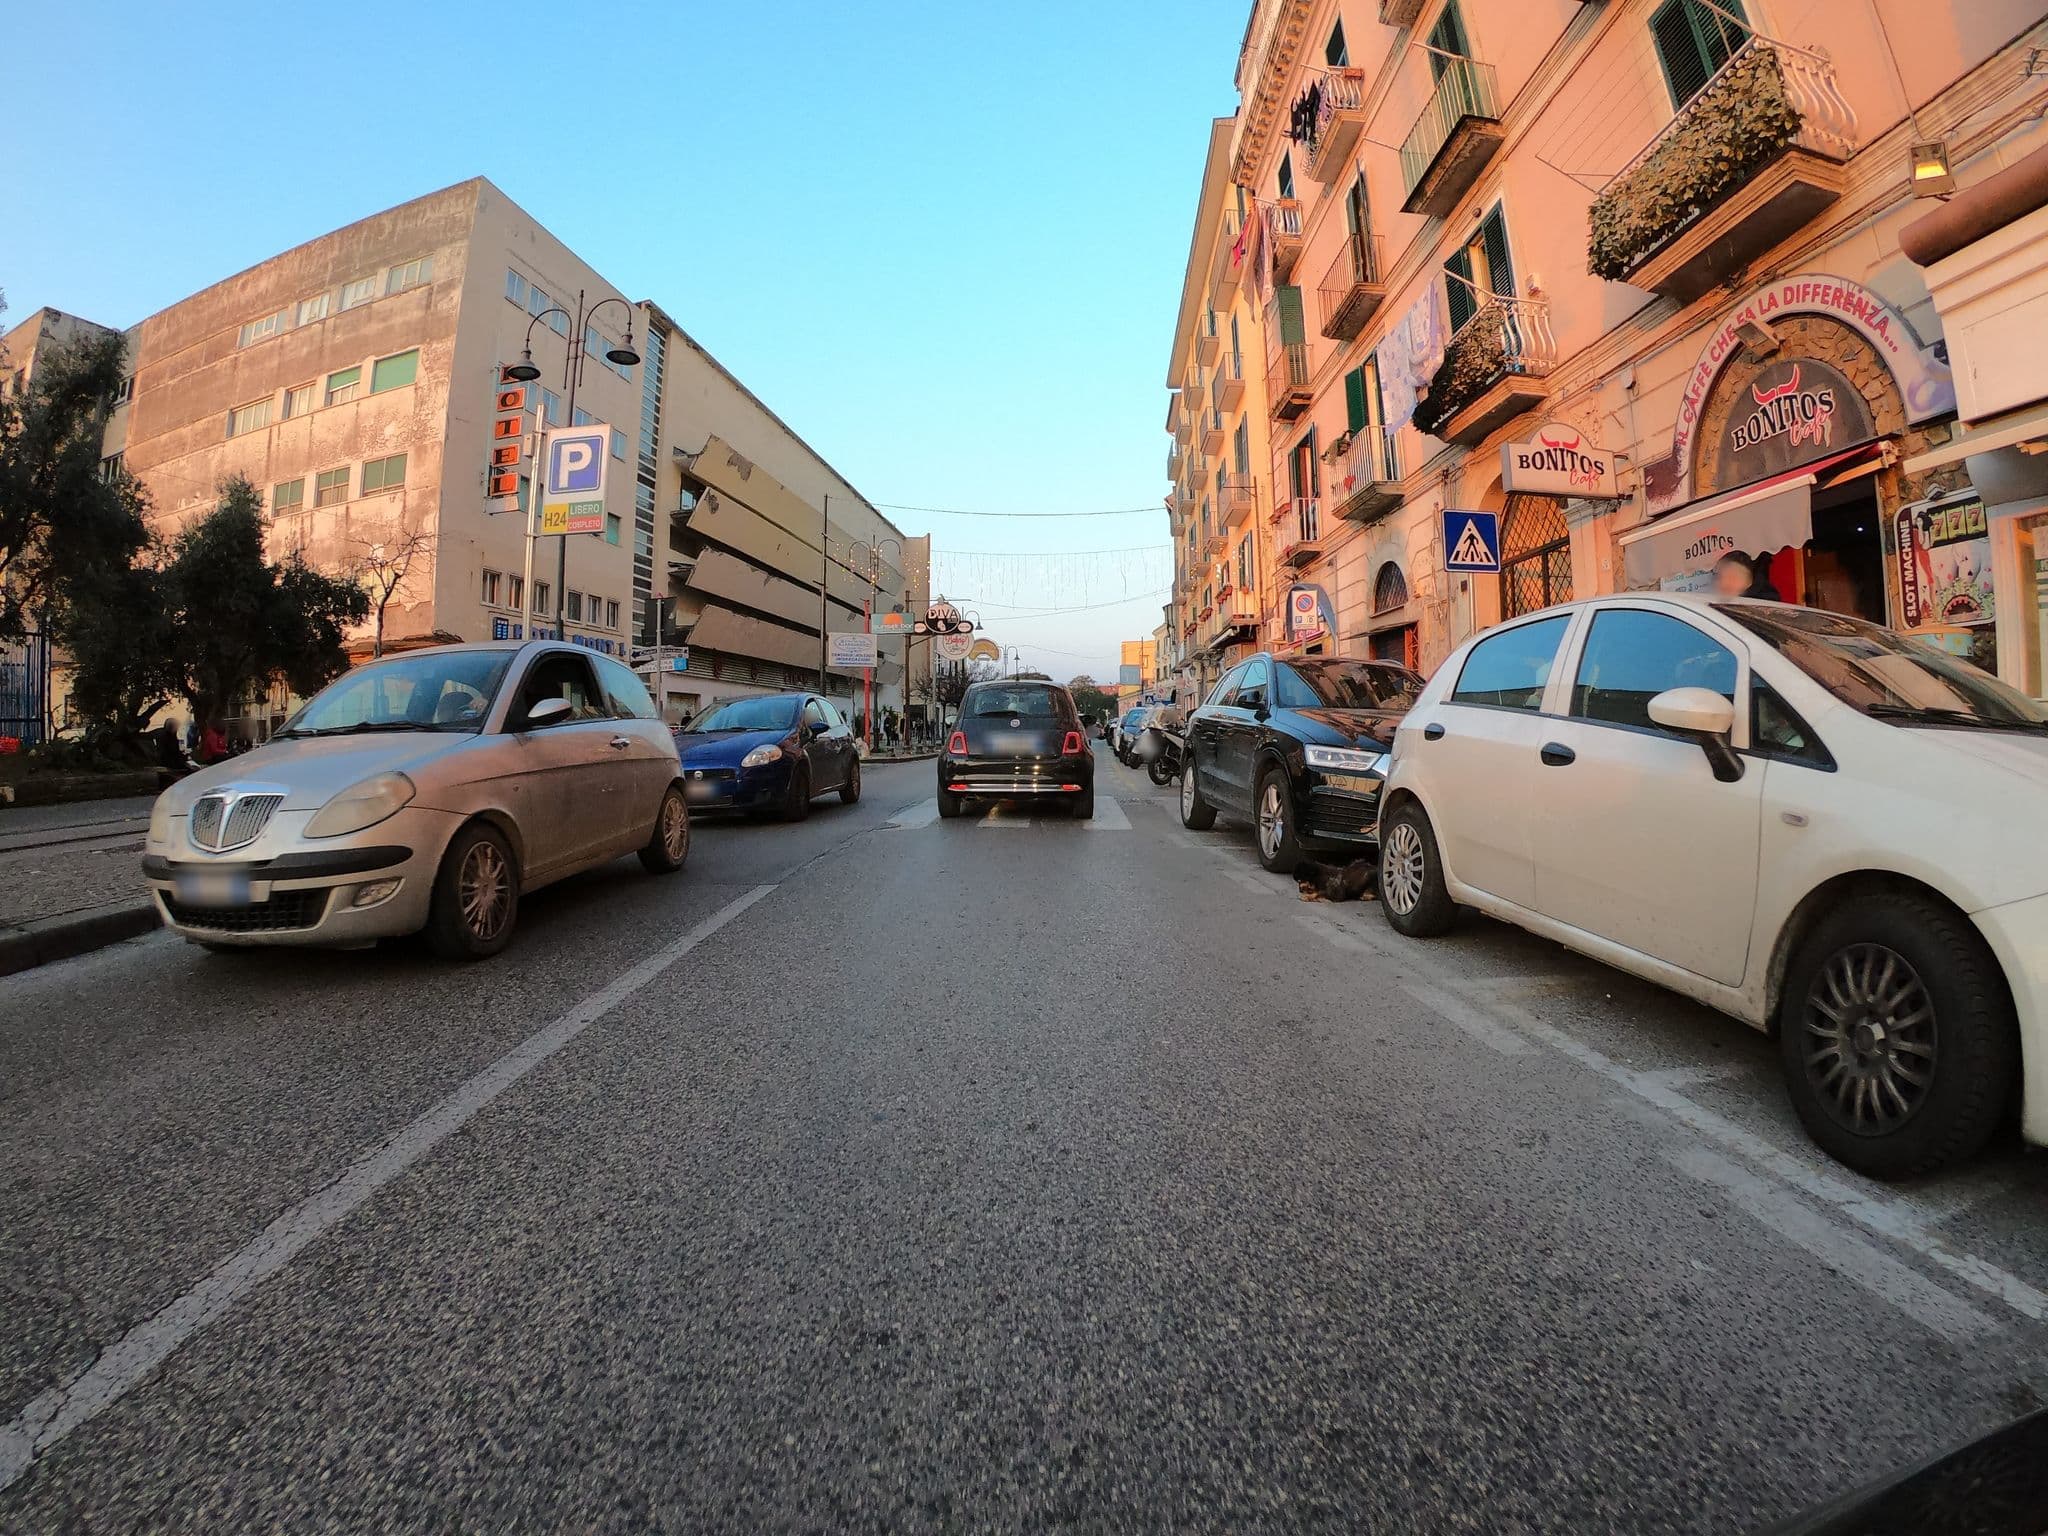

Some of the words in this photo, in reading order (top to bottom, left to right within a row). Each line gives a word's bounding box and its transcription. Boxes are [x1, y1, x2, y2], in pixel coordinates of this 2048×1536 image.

[1710, 323, 1737, 363] CHE
[1758, 291, 1780, 316] LA
[1731, 389, 1836, 452] BONITOS
[558, 442, 592, 489] P
[1517, 447, 1605, 476] BONITOS
[544, 511, 567, 528] H24
[569, 503, 600, 515] LIBERO
[1684, 534, 1735, 561] BONITOS
[1900, 519, 1914, 580] MACHINE
[927, 608, 958, 620] DIVA
[1905, 585, 1917, 618] SLOT
